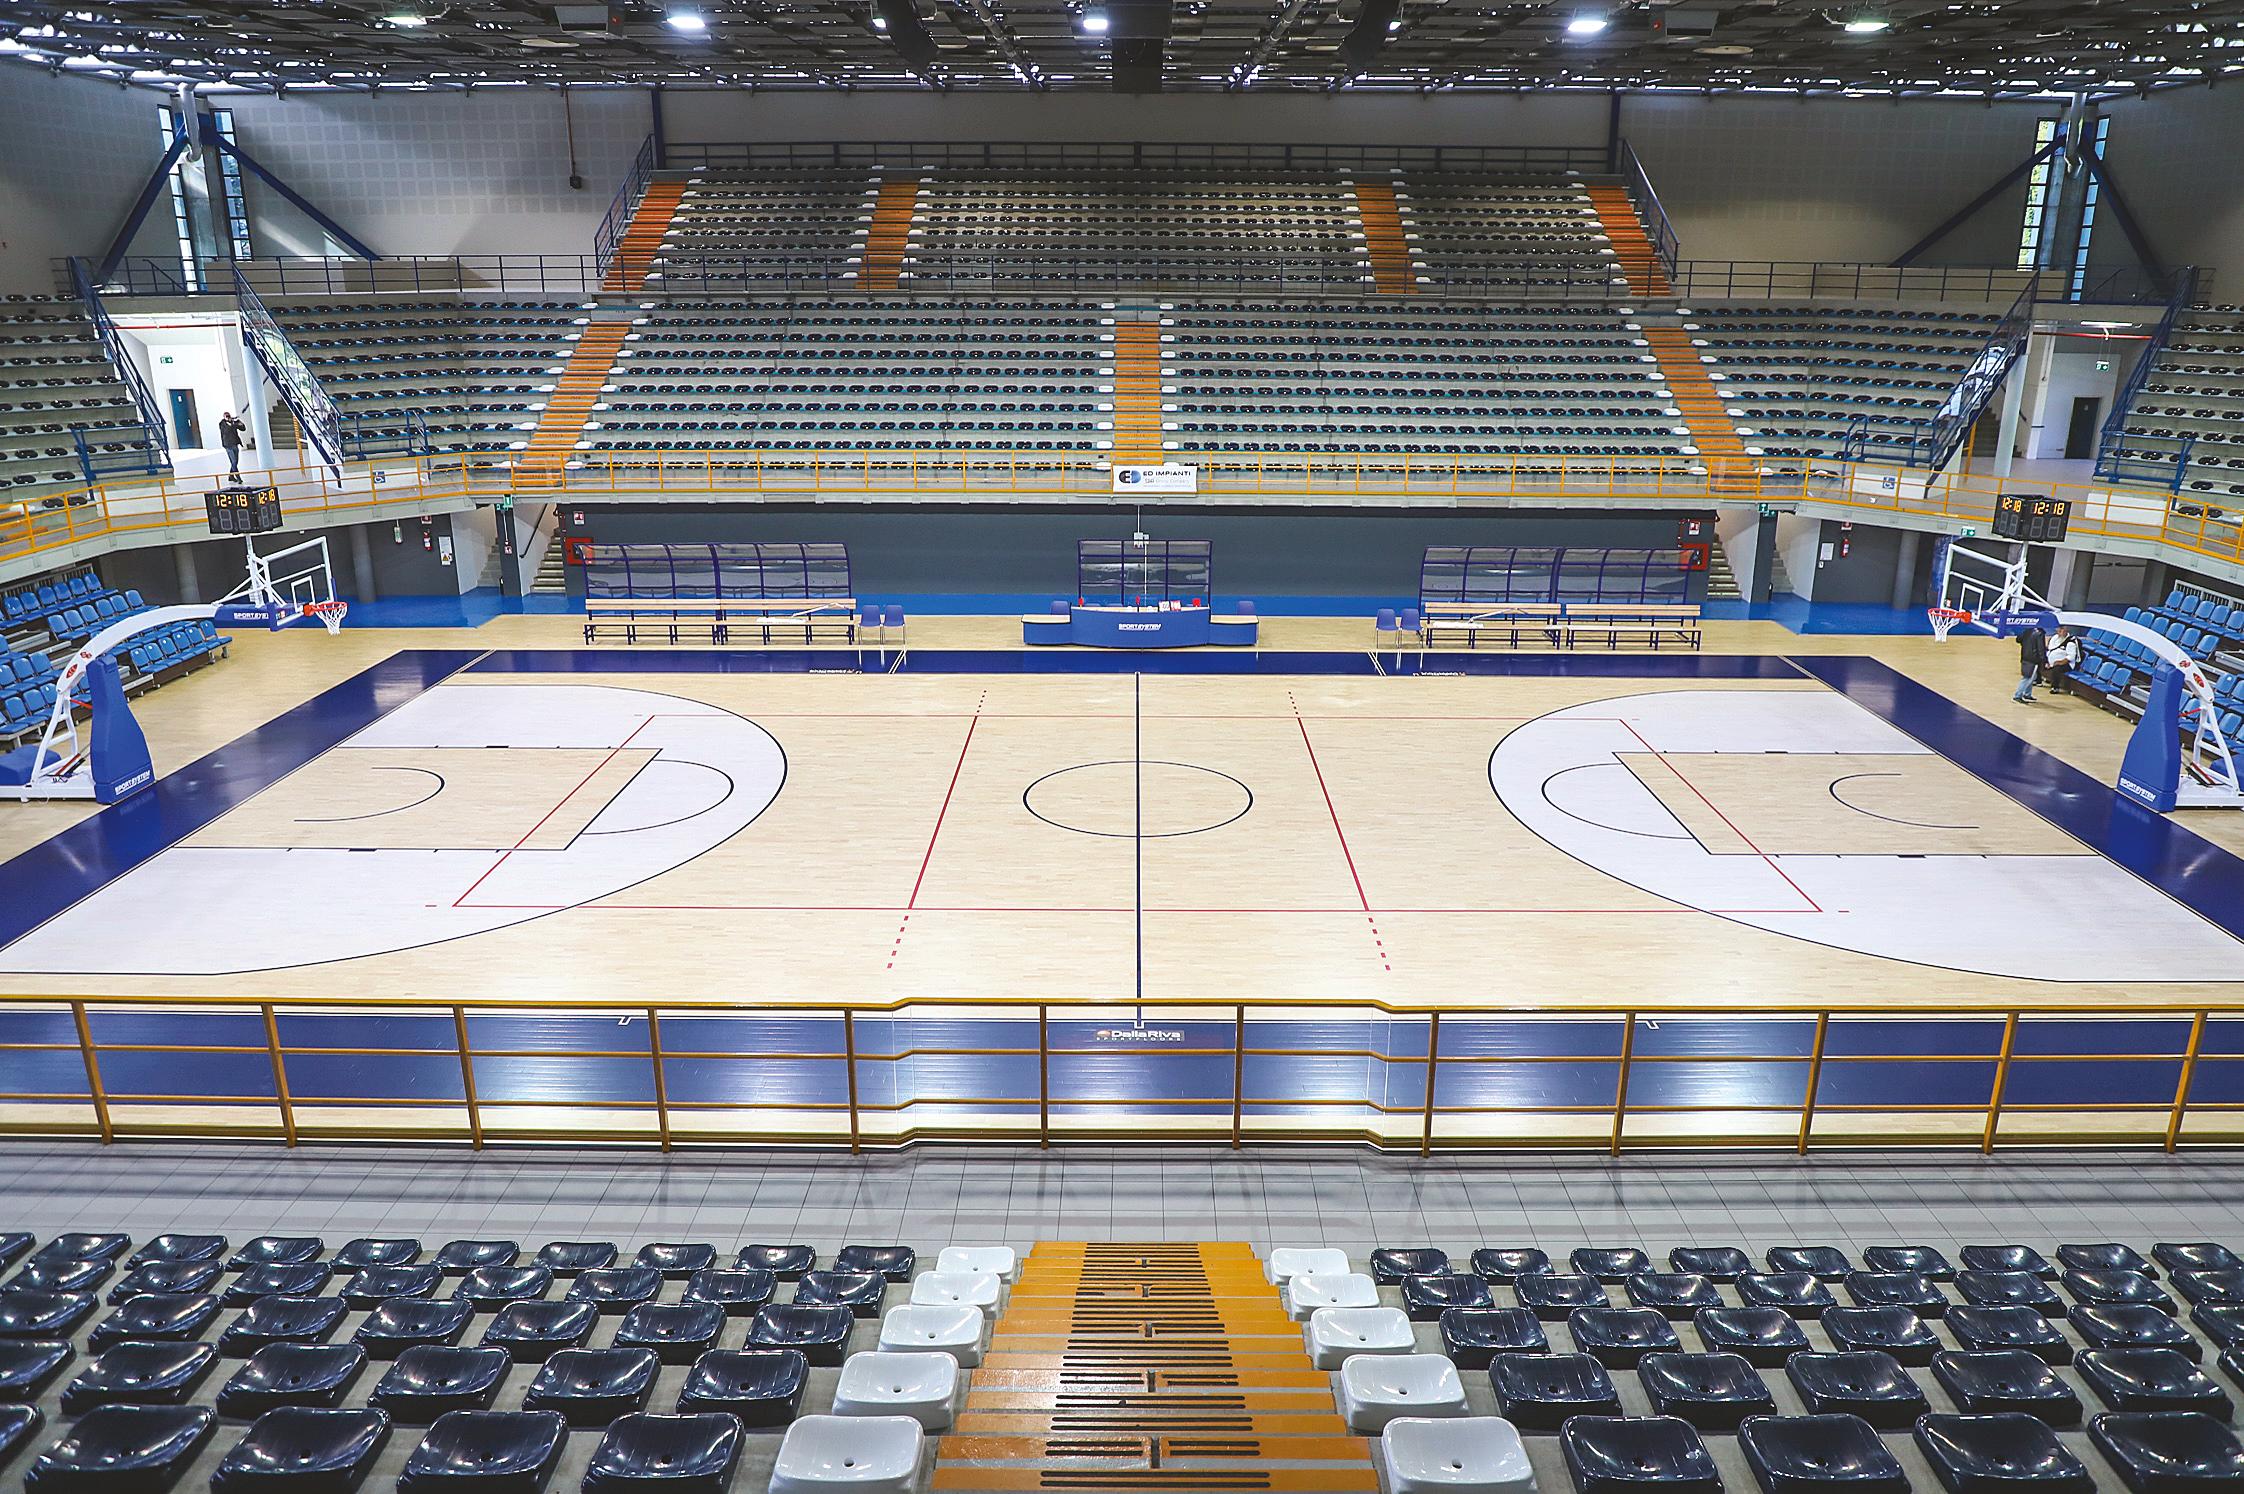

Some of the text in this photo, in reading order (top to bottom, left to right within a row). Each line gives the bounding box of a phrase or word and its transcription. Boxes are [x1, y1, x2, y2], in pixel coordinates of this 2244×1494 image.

[216, 494, 248, 508] 12:18
[258, 489, 276, 505] 12:18
[2002, 497, 2022, 513] 12:18
[2033, 501, 2065, 516] 12:18
